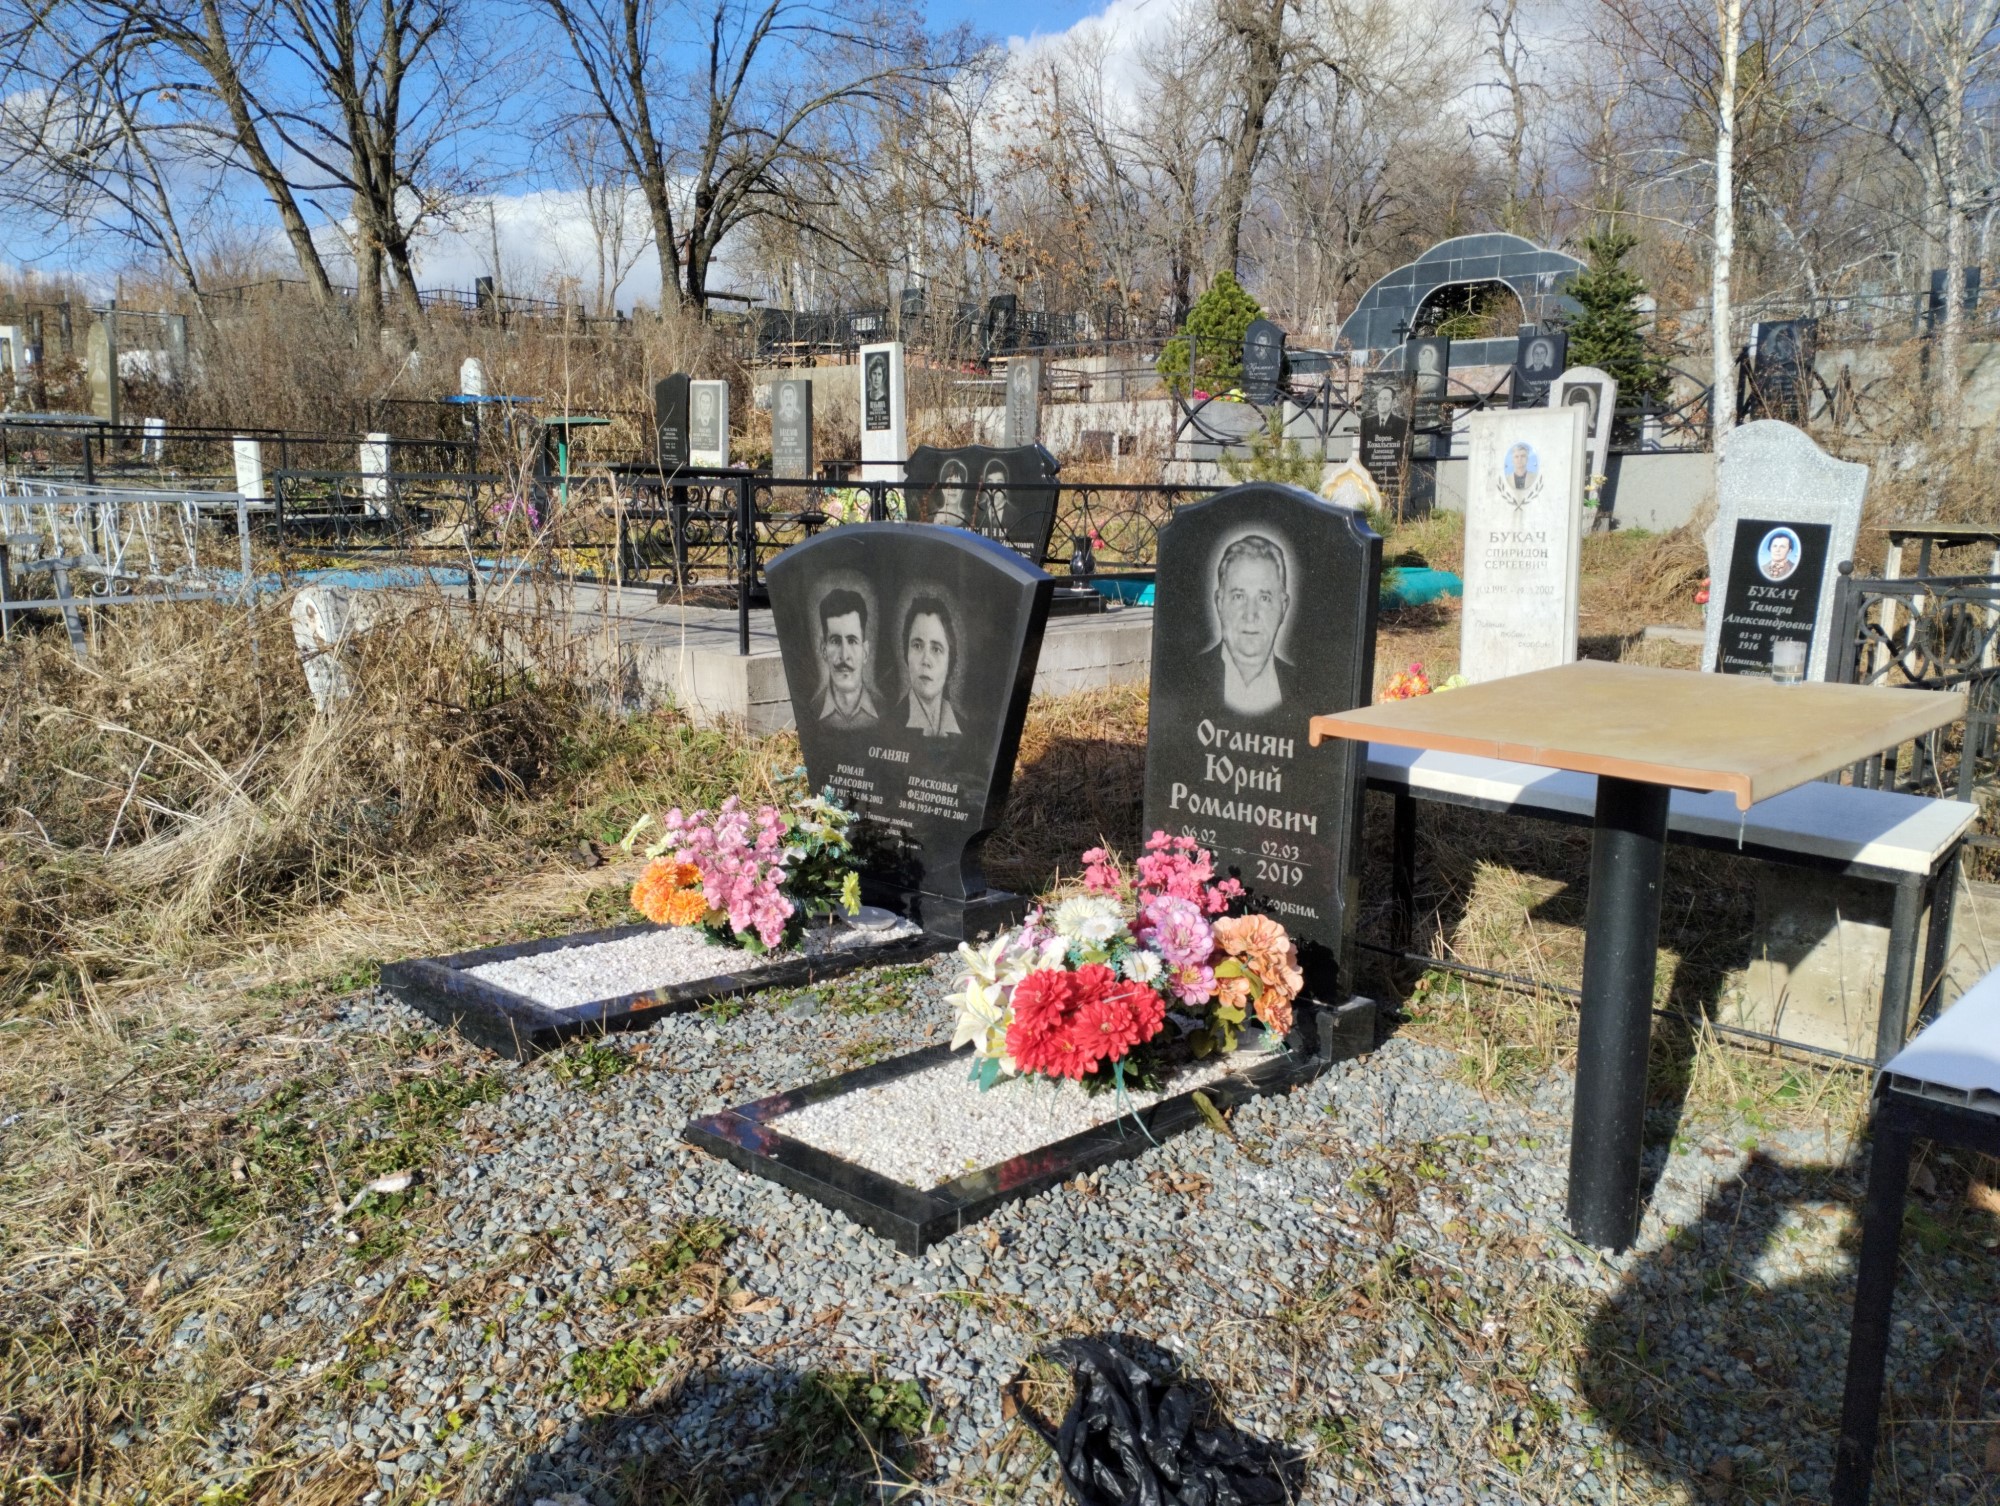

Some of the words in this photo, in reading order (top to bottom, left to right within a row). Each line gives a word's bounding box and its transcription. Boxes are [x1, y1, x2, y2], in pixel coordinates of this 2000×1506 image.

[1489, 531, 1547, 544] БУКАЧ
[1485, 548, 1549, 559] СПИРИДОН
[1484, 560, 1549, 570] СЕРГЕЕВИЧ
[1747, 586, 1799, 600] БУКАЧ
[1749, 600, 1794, 615] Тамара
[1723, 613, 1813, 631] Александровна
[1738, 641, 1759, 651] 1916
[1724, 654, 1765, 667] Помним,
[1739, 668, 1774, 678] скорби
[1197, 718, 1295, 759] Оганян
[868, 746, 910, 763] ОГАНЯН
[836, 763, 865, 777] РОМАН
[1204, 753, 1282, 795] Юрий
[828, 774, 875, 791] ТАРАСОВИЧ
[908, 776, 959, 794] ПРАСКОВЬЯ
[907, 789, 960, 808] ФЕДОРОВНА
[1169, 782, 1318, 836] Романович
[1181, 825, 1217, 844] 06.02
[1261, 840, 1300, 861] 02.03
[1256, 859, 1303, 887] 2019
